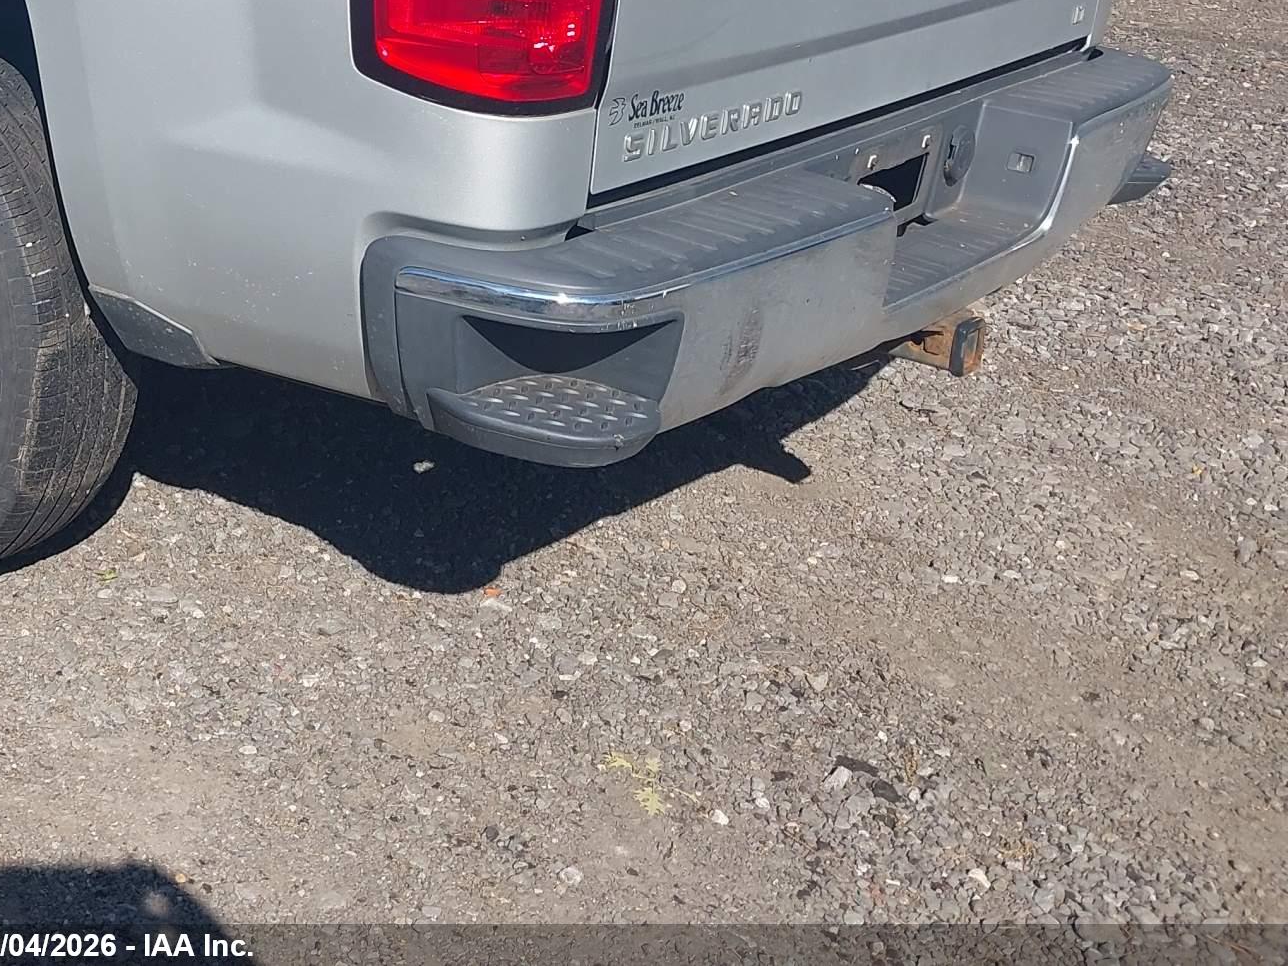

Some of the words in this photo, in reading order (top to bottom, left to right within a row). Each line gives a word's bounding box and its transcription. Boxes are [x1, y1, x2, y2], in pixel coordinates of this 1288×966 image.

[623, 91, 803, 163] SILVERADO
[628, 94, 647, 121] Sea
[649, 90, 685, 116] Breeze
